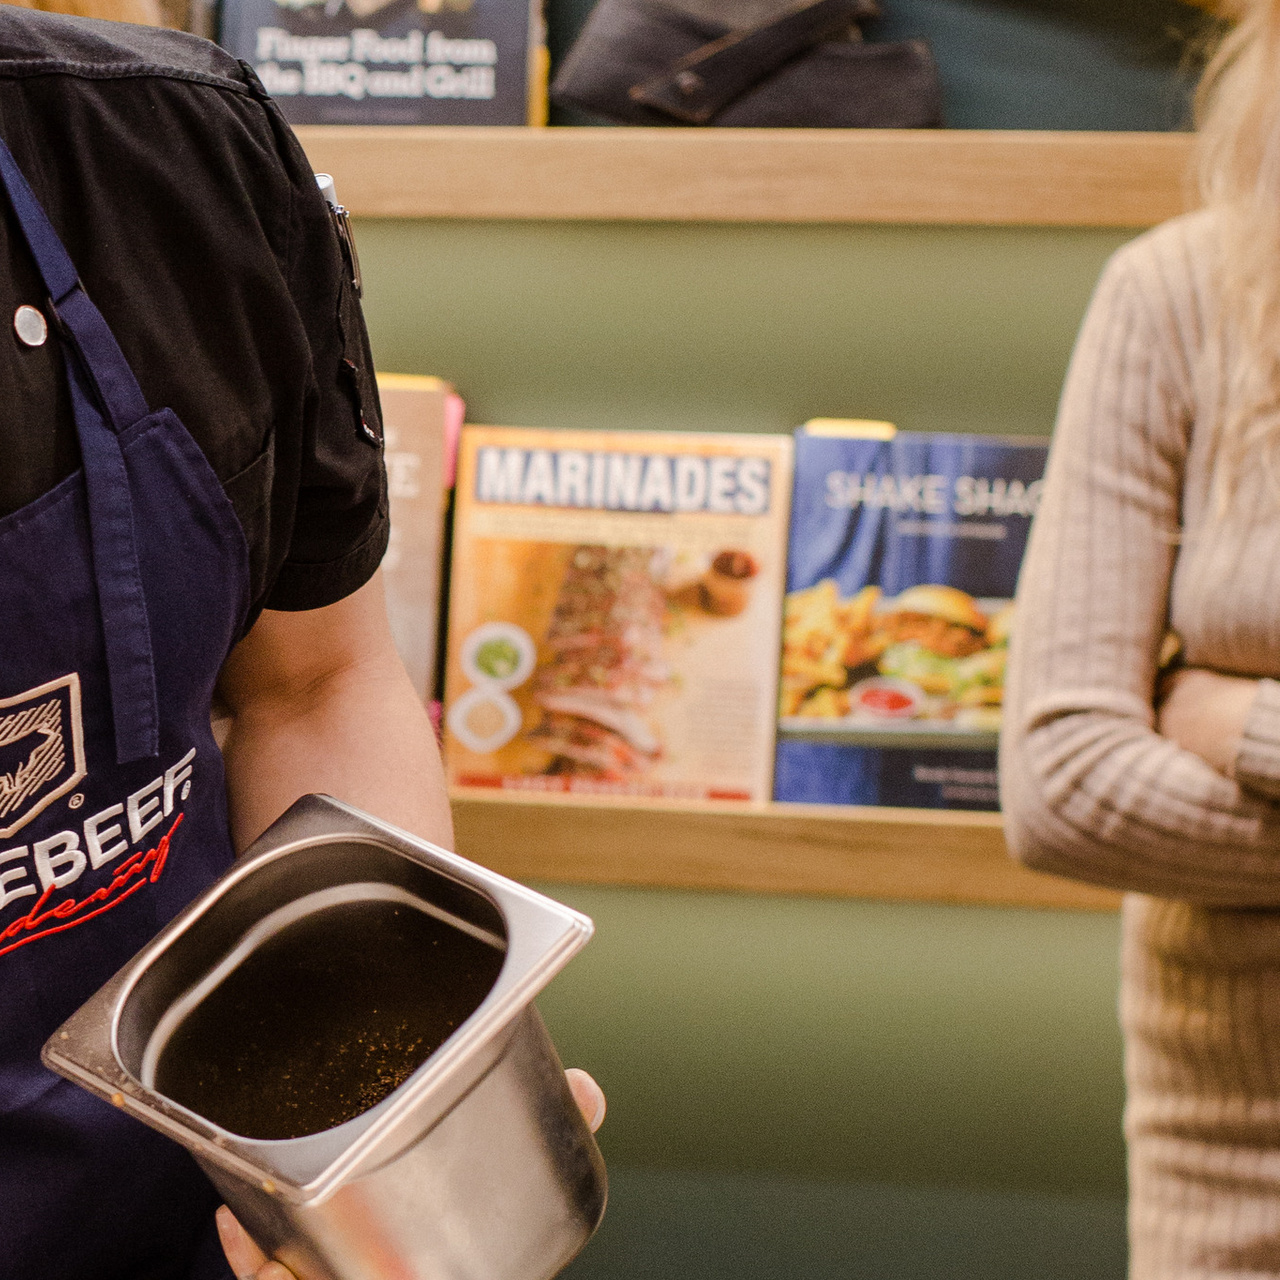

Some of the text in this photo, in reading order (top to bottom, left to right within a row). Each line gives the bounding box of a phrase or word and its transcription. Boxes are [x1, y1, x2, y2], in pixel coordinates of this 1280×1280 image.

[351, 27, 424, 63] Food
[426, 30, 498, 65] from
[477, 446, 772, 515] MARINADES
[824, 469, 948, 515] SHAKE
